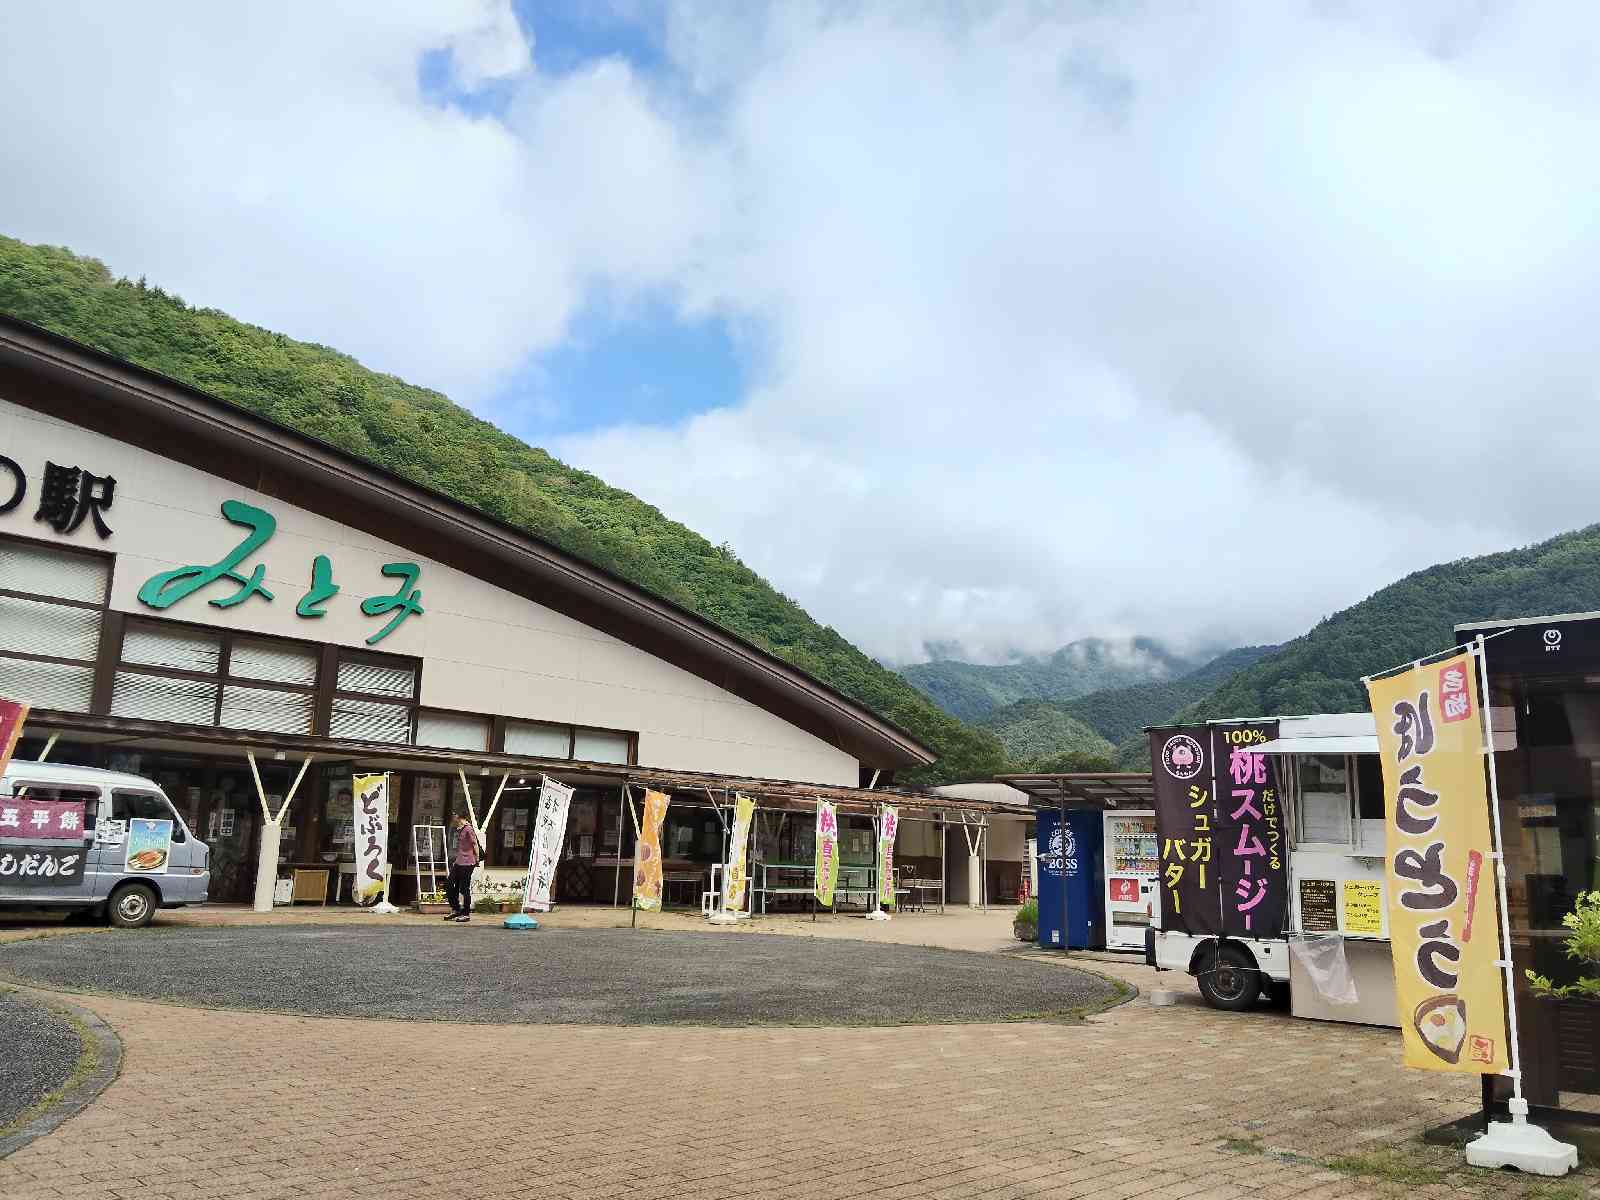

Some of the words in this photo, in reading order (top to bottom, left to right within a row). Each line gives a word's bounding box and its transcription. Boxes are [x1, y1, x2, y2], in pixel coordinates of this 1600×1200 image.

[137, 499, 425, 646] みとみ
[1223, 730, 1266, 744] 100%
[0, 808, 80, 830] 五平餅
[361, 783, 384, 882] どぶろく
[1189, 784, 1212, 889] シュガー
[1229, 745, 1268, 930] 桃スムージー
[1262, 789, 1281, 870] だけでつくる
[1048, 858, 1078, 869] BOSS
[1162, 838, 1187, 915] バター
